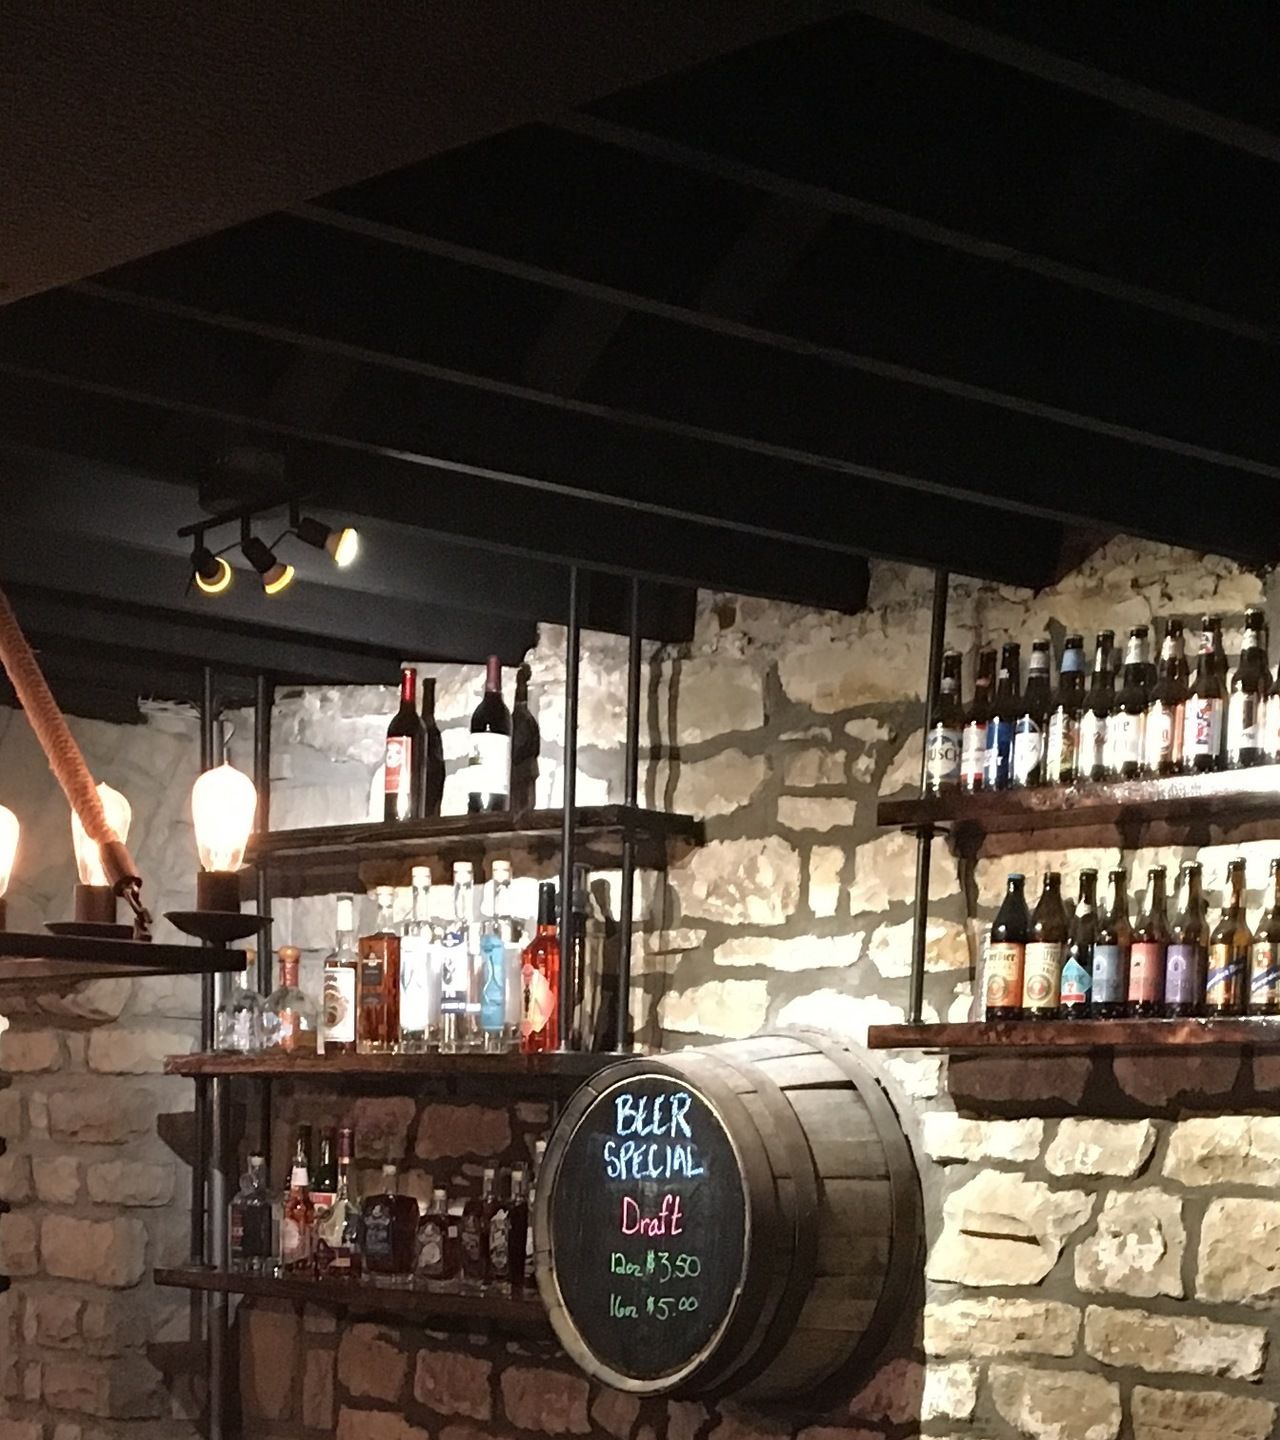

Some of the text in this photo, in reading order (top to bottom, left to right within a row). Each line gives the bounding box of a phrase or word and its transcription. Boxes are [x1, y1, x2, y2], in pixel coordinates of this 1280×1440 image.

[927, 747, 961, 762] USCH
[614, 1092, 693, 1139] BEER
[603, 1140, 704, 1179] SPECIAL
[620, 1194, 684, 1237] Draft
